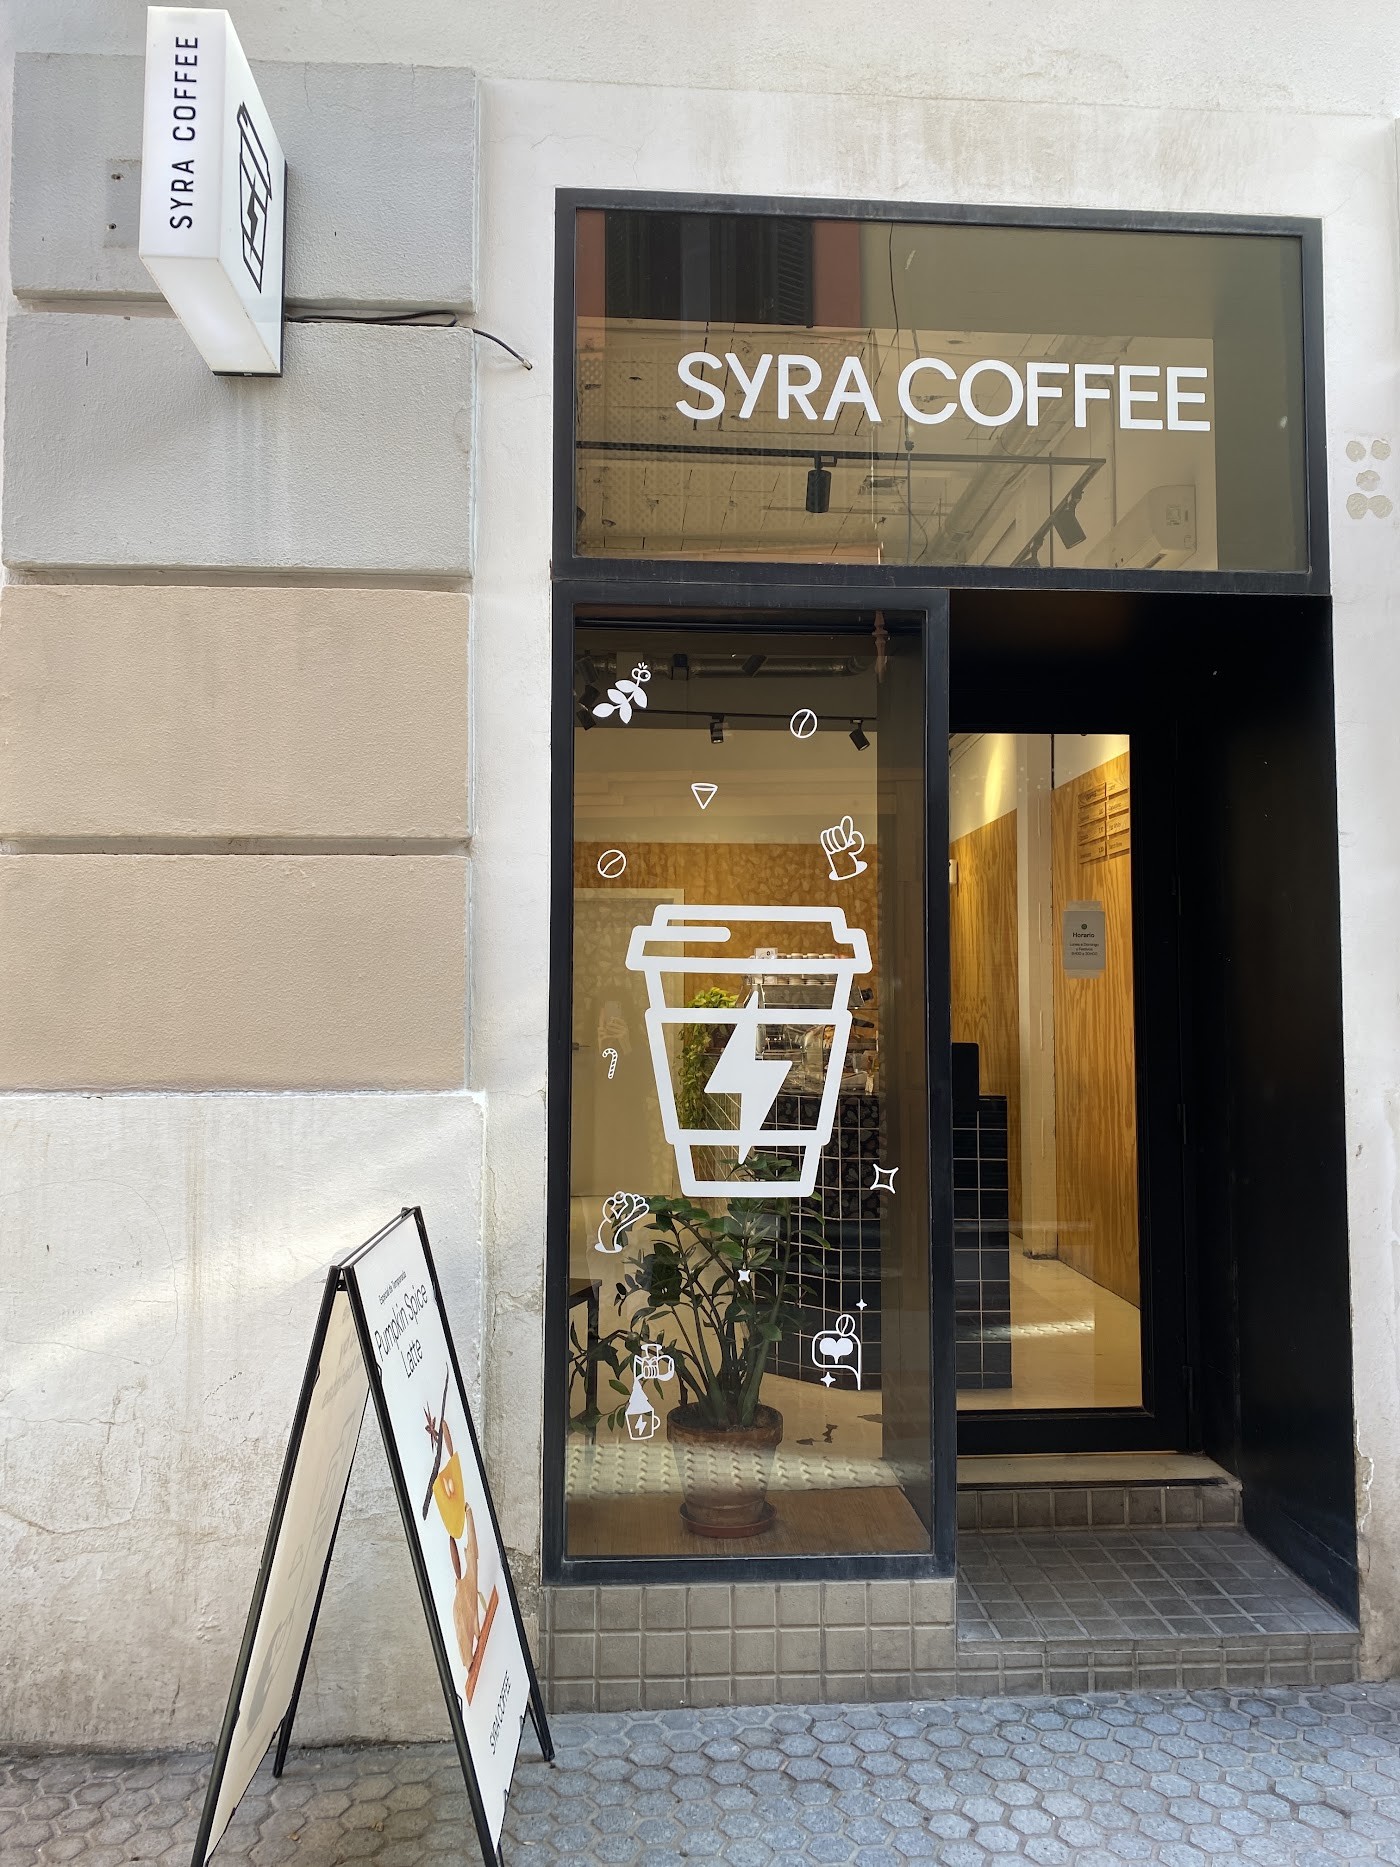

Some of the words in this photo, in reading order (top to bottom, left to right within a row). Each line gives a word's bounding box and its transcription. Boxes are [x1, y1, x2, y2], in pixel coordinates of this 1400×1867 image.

[172, 36, 198, 141] COFFEE
[170, 160, 194, 229] SYRA
[675, 352, 882, 422] SYRA
[897, 357, 1211, 432] COFFEE
[374, 1303, 409, 1362] Pumpkin
[404, 1284, 428, 1325] Spice
[400, 1339, 422, 1379] Latte
